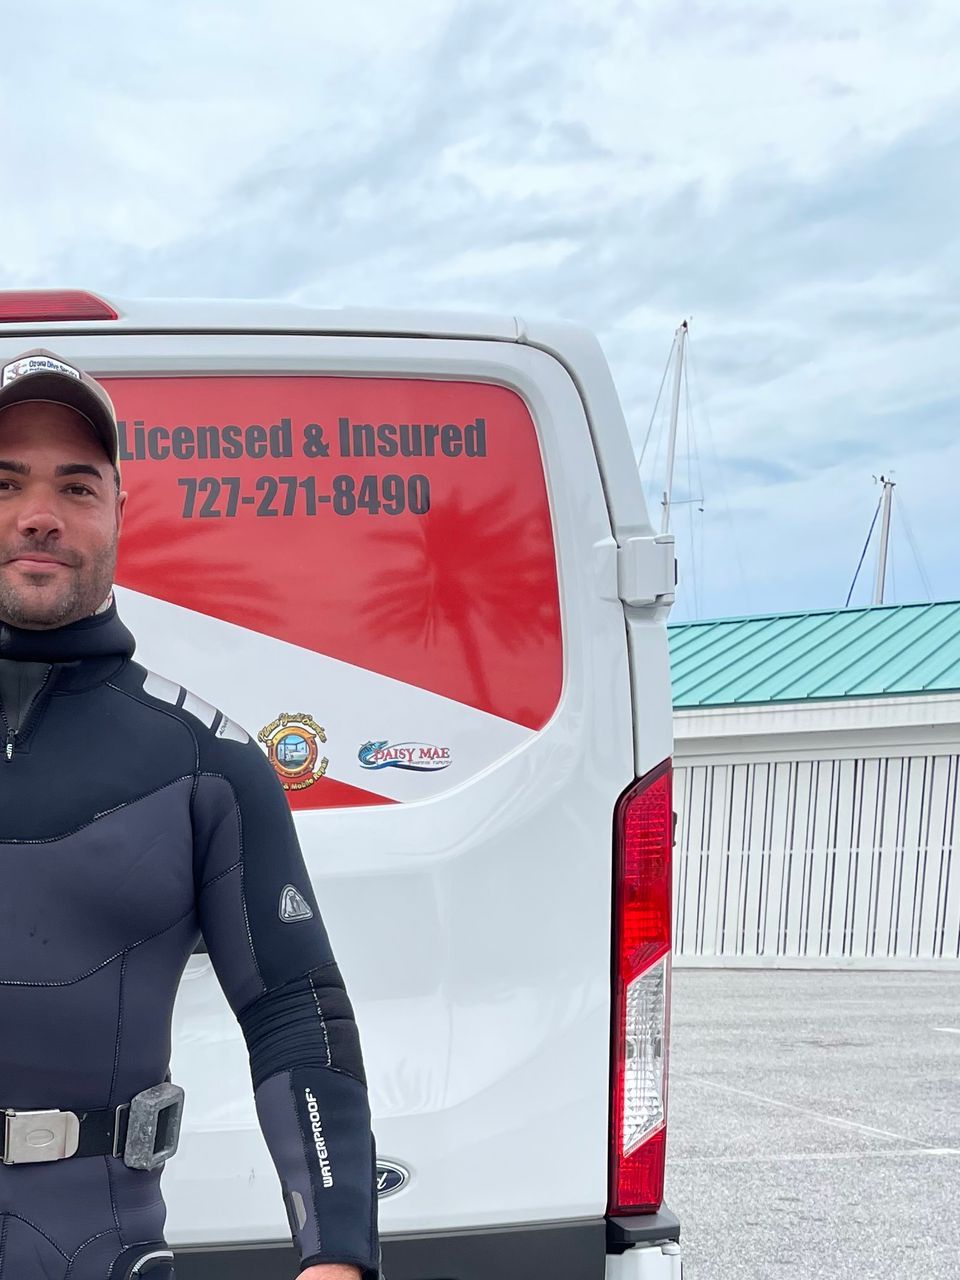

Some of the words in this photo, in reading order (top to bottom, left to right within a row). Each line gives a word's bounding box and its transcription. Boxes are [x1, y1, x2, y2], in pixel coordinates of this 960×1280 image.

[118, 418, 293, 461] Licensed
[303, 423, 330, 459] &
[339, 417, 488, 459] Insured
[178, 474, 431, 519] 727-271-8490
[373, 748, 415, 763] DAISY
[419, 747, 450, 760] MAE
[305, 1091, 334, 1188] WATERPROOF
